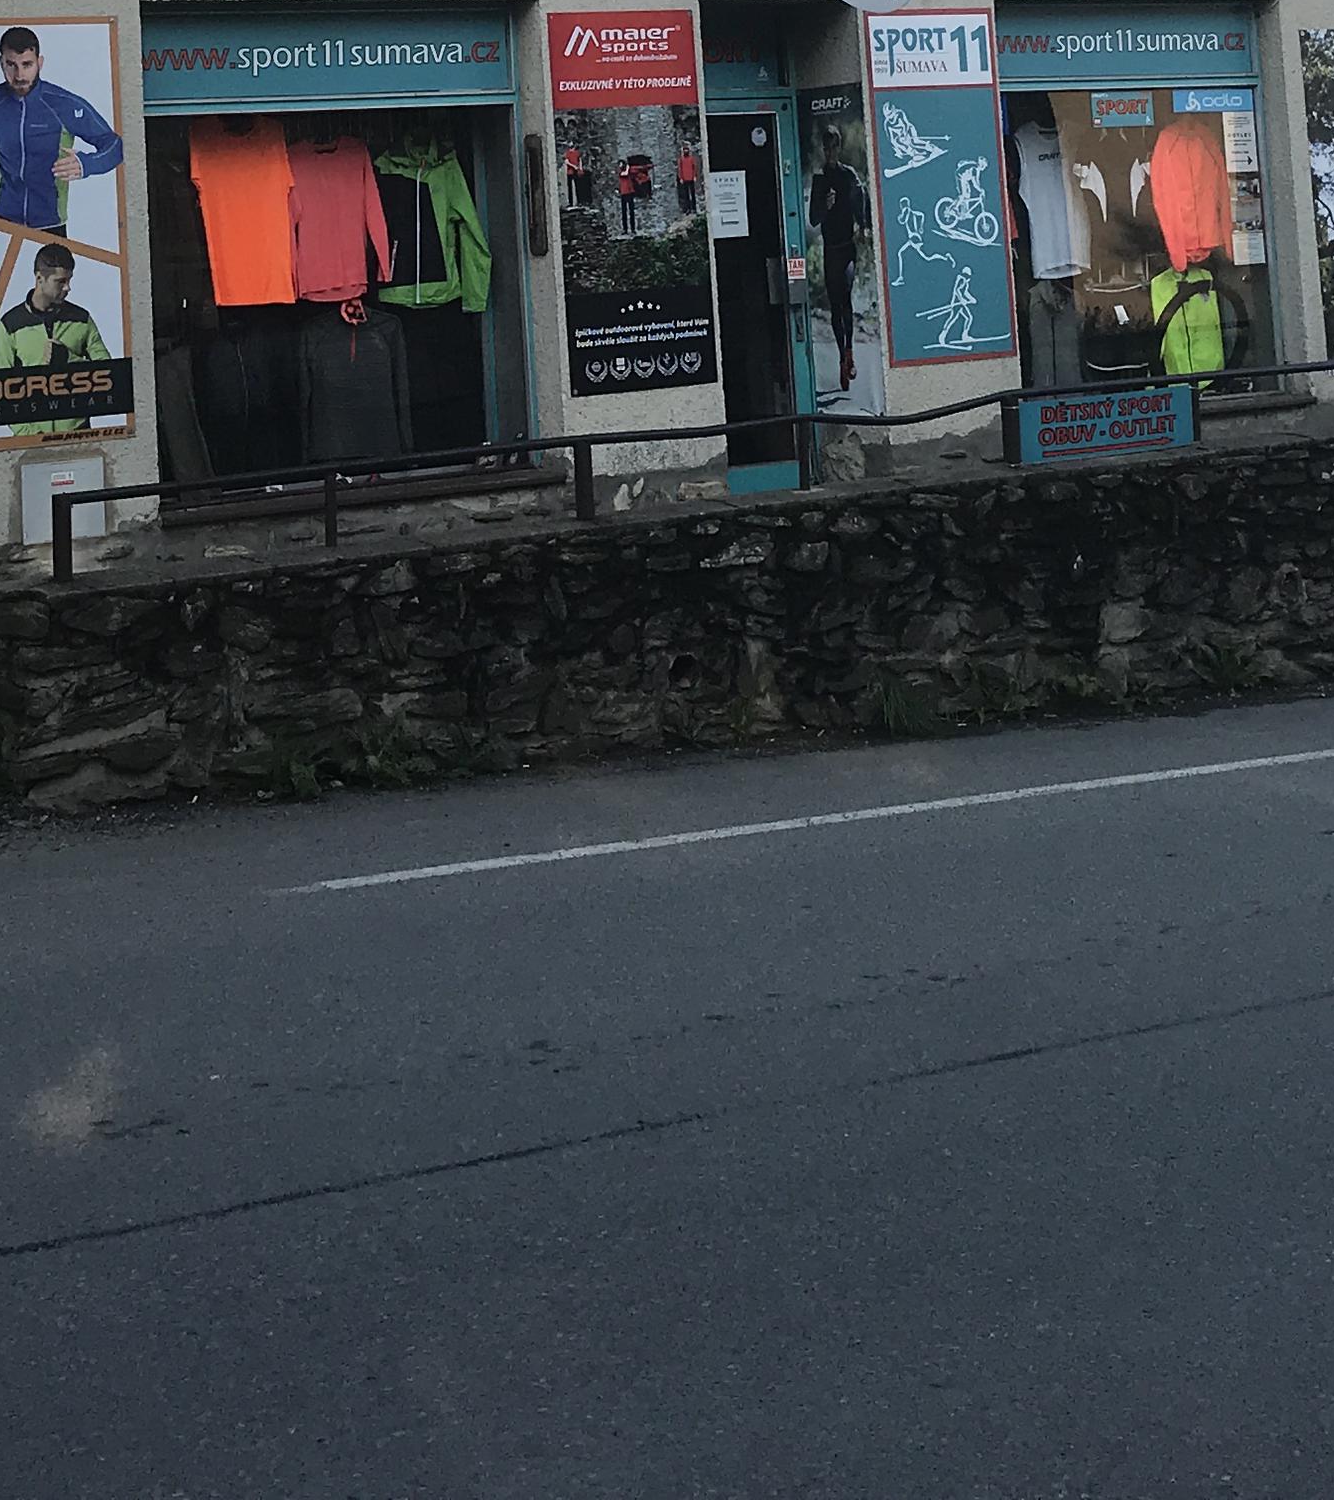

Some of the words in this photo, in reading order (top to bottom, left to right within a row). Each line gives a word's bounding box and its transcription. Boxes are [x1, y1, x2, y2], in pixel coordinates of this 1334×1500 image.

[600, 26, 676, 41] maier
[601, 41, 669, 53] sports
[873, 27, 947, 76] SPORT
[950, 25, 988, 72] 11
[996, 29, 1245, 60] www.sport11sumava.cz
[142, 39, 500, 77] www.sport11sumava.cz
[895, 57, 948, 74] ŠUMAVA
[559, 77, 614, 91] EXKLUZIVNĚ
[615, 79, 622, 89] V
[623, 77, 646, 89] TÉTO
[647, 75, 692, 88] PRODEJNĚ
[811, 96, 844, 110] CRAFT
[1097, 99, 1148, 115] SPORT
[1202, 93, 1243, 107] odlo
[1040, 396, 1114, 424] DĚTSKÝ
[1118, 393, 1173, 416] SPORT
[1038, 423, 1097, 446] OBUV
[1109, 414, 1177, 439] OUTLET
